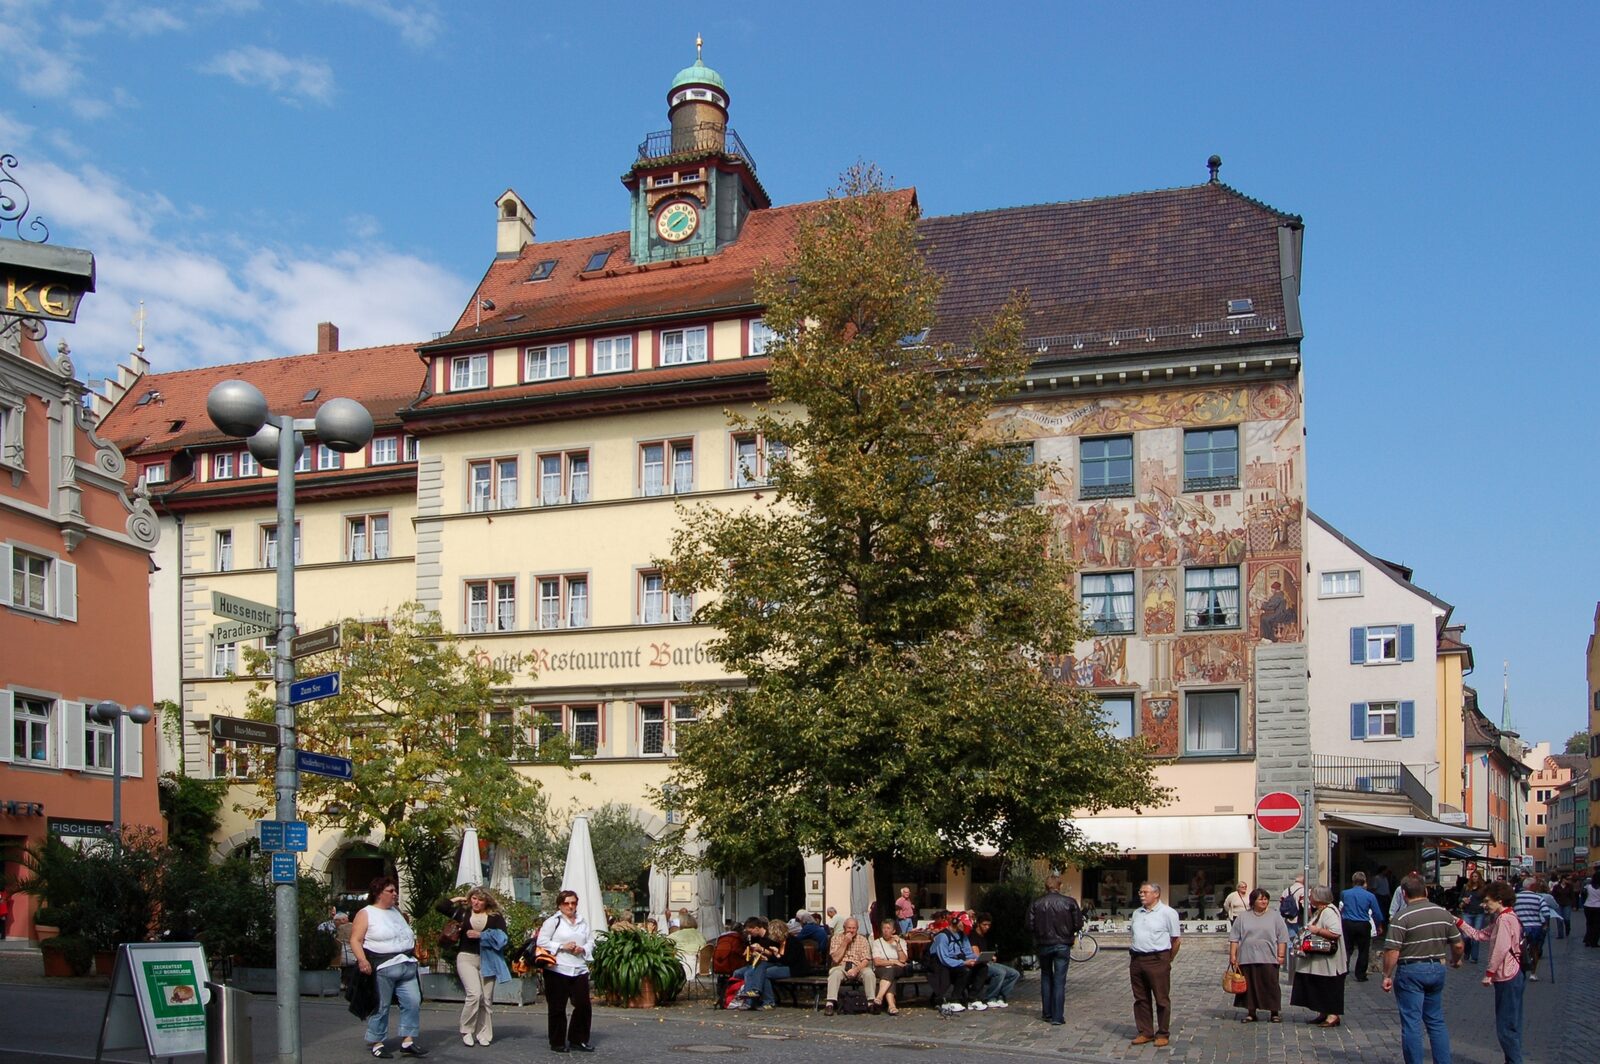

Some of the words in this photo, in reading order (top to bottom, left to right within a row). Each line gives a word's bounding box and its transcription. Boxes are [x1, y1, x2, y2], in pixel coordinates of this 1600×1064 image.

[220, 596, 272, 625] Hussenstr.
[217, 624, 269, 640] Paradiess
[531, 645, 641, 673] Restaurant
[300, 686, 312, 696] Zum
[313, 684, 321, 693] See
[234, 724, 268, 738] Hus-Museum
[52, 823, 102, 834] FISCHER
